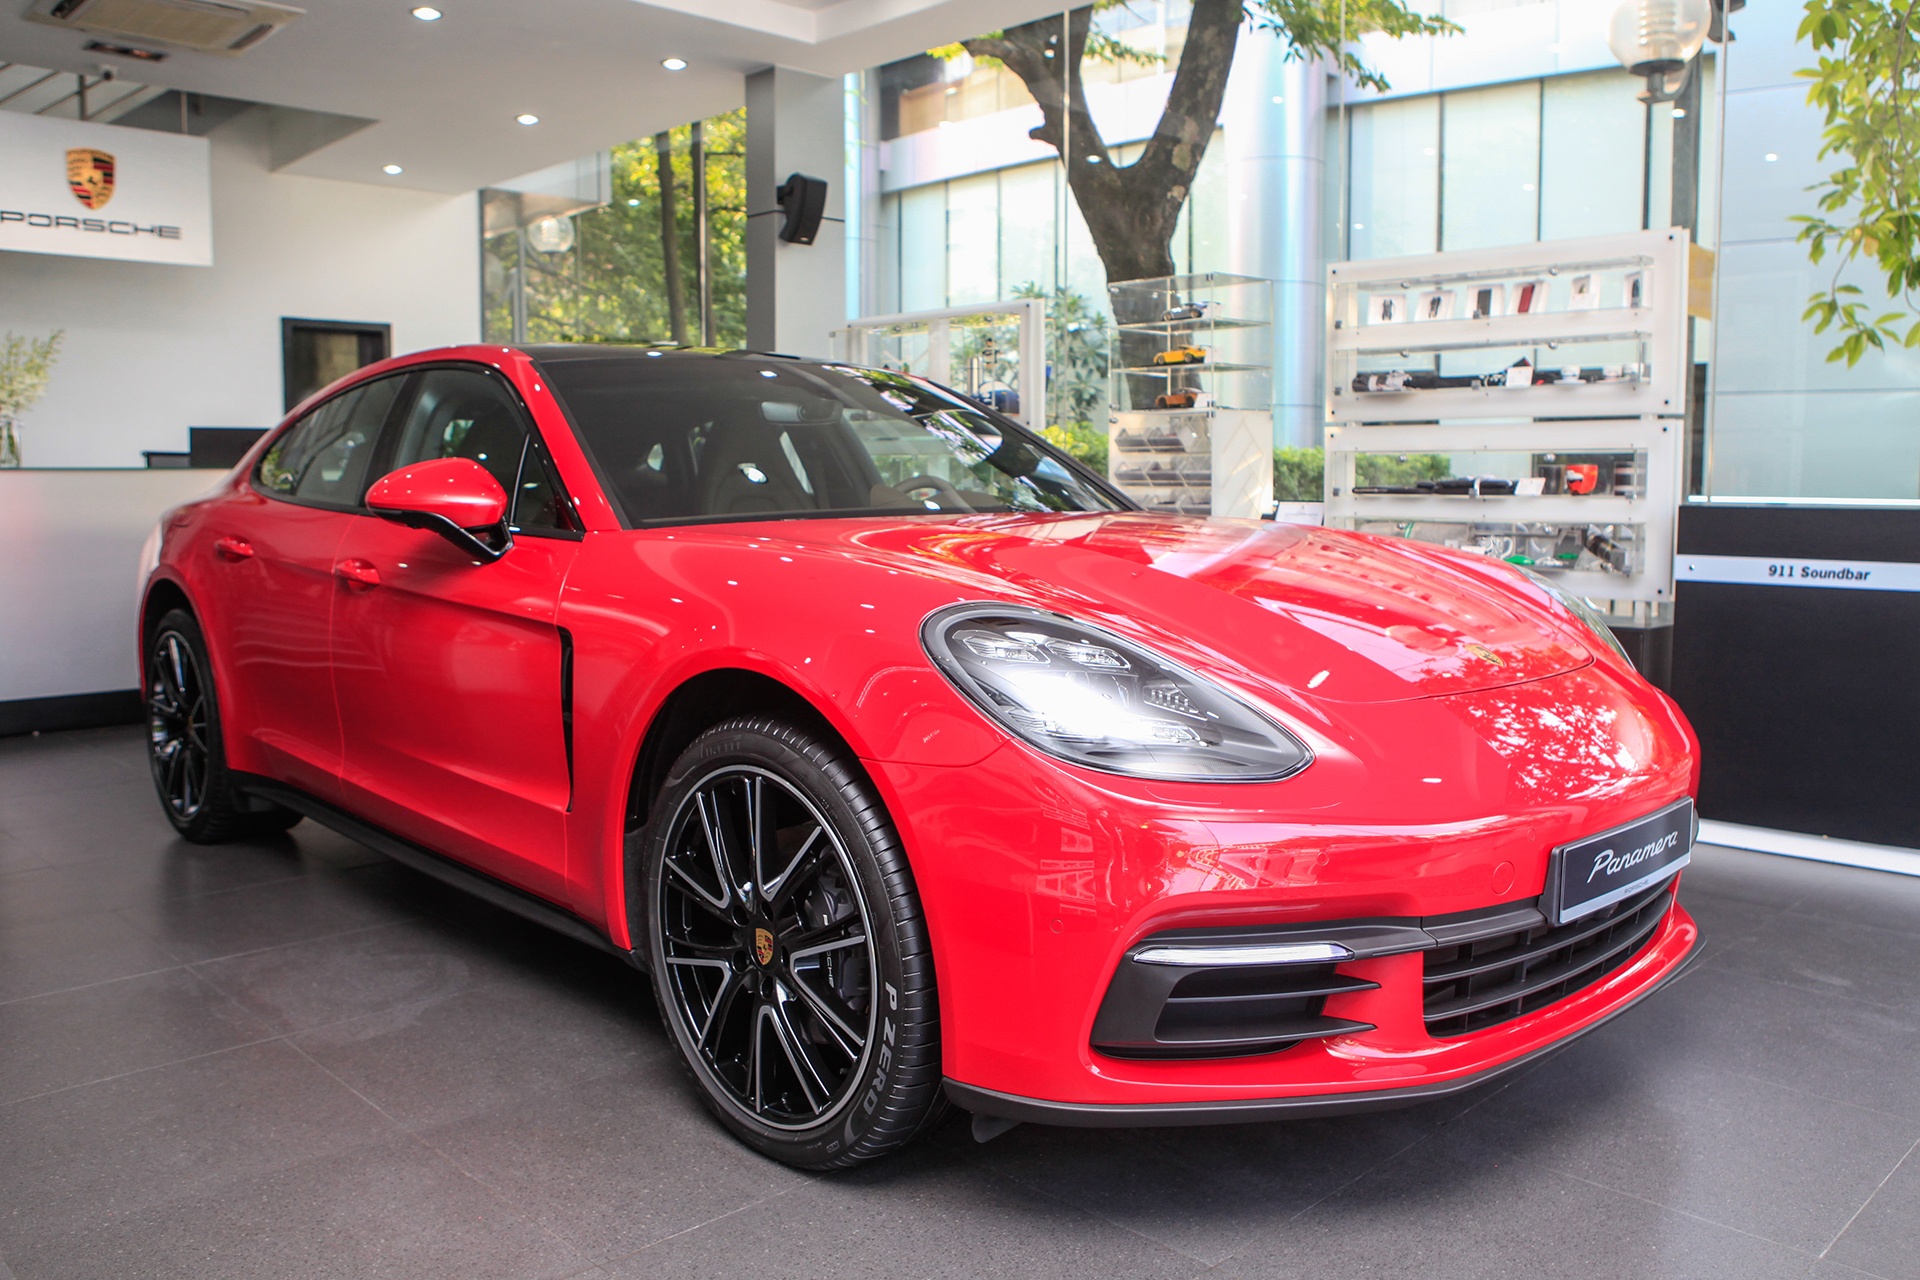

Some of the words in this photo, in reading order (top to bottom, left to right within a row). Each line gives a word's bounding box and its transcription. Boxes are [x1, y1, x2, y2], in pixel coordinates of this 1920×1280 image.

[0, 210, 182, 239] PORSCHE
[1768, 564, 1795, 577] 911
[1800, 566, 1871, 581] Soundbar
[1586, 831, 1679, 884] Panamera
[885, 981, 898, 1011] P
[863, 1016, 896, 1115] ZERO
